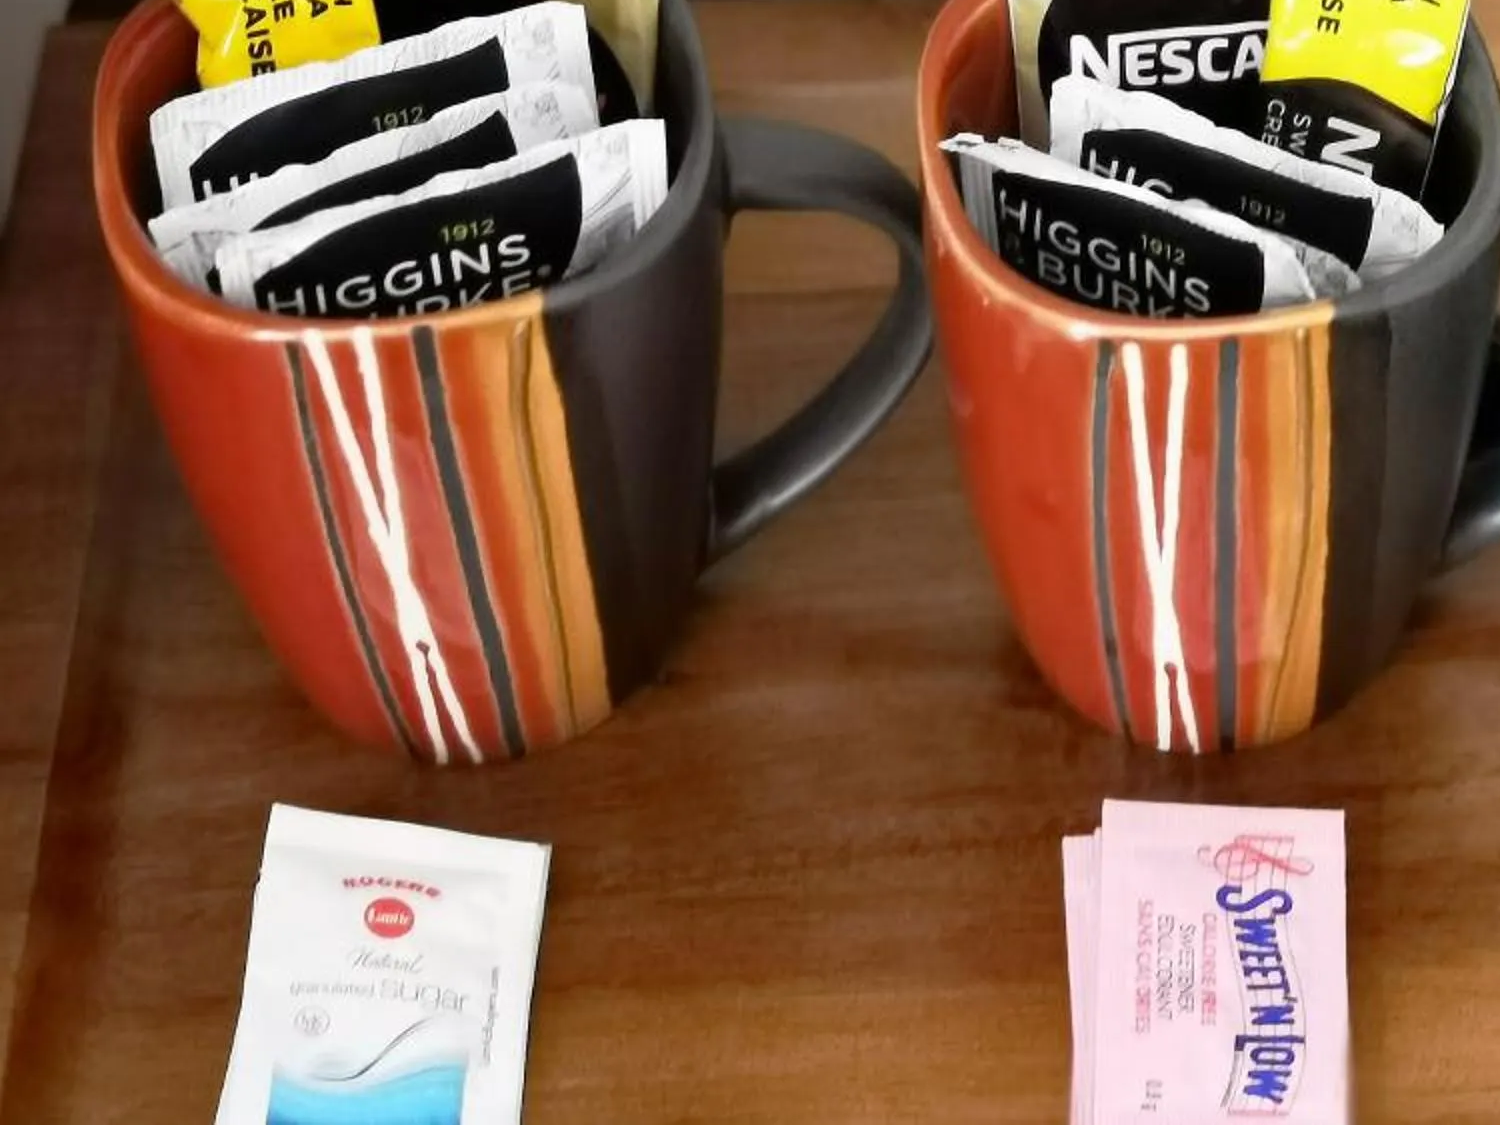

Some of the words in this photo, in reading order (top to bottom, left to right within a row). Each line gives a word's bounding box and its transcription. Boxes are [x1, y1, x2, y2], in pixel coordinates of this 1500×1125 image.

[1070, 29, 1267, 87] NESCA
[371, 106, 426, 132] 1912
[440, 219, 494, 243] 1912
[1000, 188, 1211, 312] HIGGINS
[268, 234, 531, 316] HIGGINS
[1036, 248, 1208, 319] BURK
